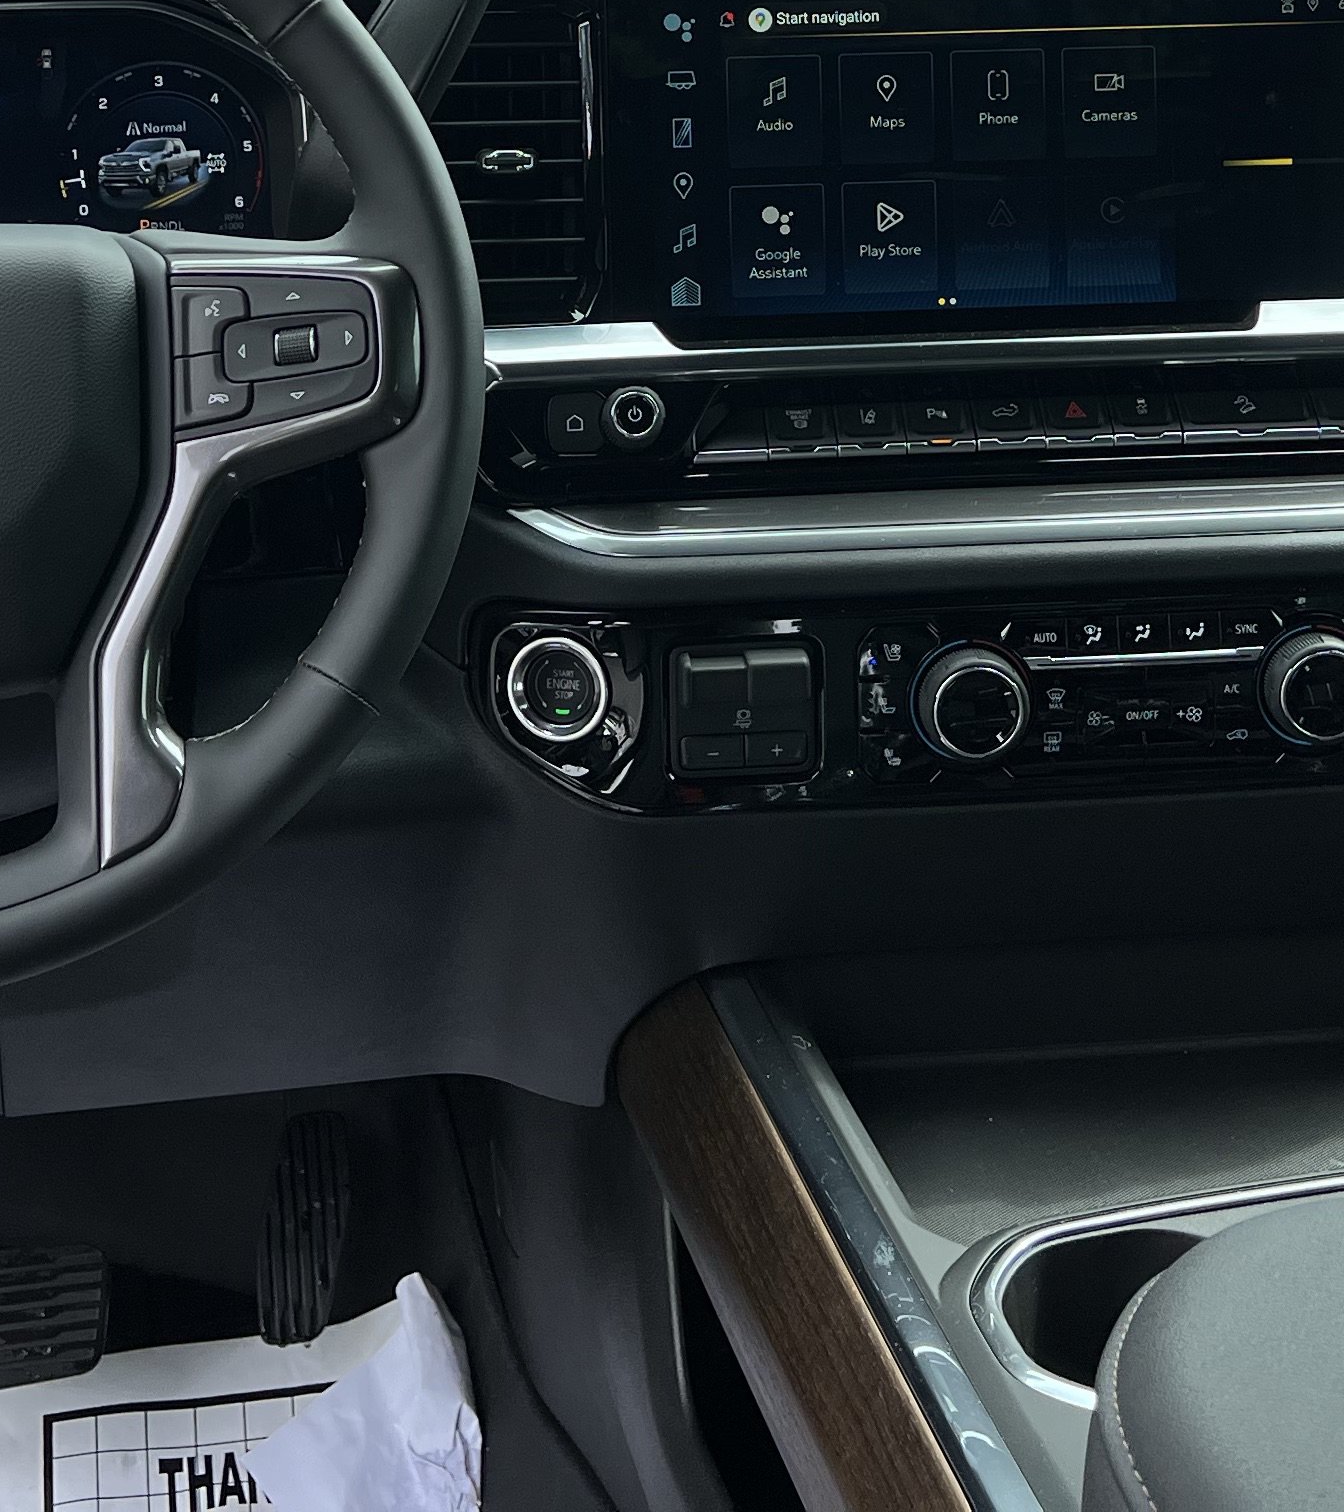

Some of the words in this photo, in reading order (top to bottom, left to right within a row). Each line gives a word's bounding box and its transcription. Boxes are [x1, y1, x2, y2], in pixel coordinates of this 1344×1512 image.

[776, 10, 809, 26] Start
[811, 9, 880, 28] navigation
[154, 75, 164, 87] 3
[98, 97, 108, 110] 2
[209, 92, 220, 104] 4
[978, 111, 1019, 125] Phone
[1081, 109, 1139, 123] Cameras
[143, 120, 187, 134] Normal
[756, 118, 794, 132] Audio
[869, 116, 906, 131] Maps
[242, 140, 253, 152] 5
[71, 148, 78, 161] 1
[234, 196, 244, 208] 6
[79, 204, 90, 216] 0
[755, 248, 801, 264] Google
[859, 244, 886, 260] Play
[889, 243, 922, 257] Store
[748, 265, 808, 279] Assistant
[1234, 623, 1259, 635] SYNC
[1033, 632, 1058, 643] AUTO
[552, 668, 575, 677] START
[546, 678, 581, 691] ENGINE
[1223, 684, 1241, 694] A/C
[554, 690, 574, 700] STOP
[1048, 701, 1064, 710] MAX
[1125, 709, 1160, 721] ON/OFF
